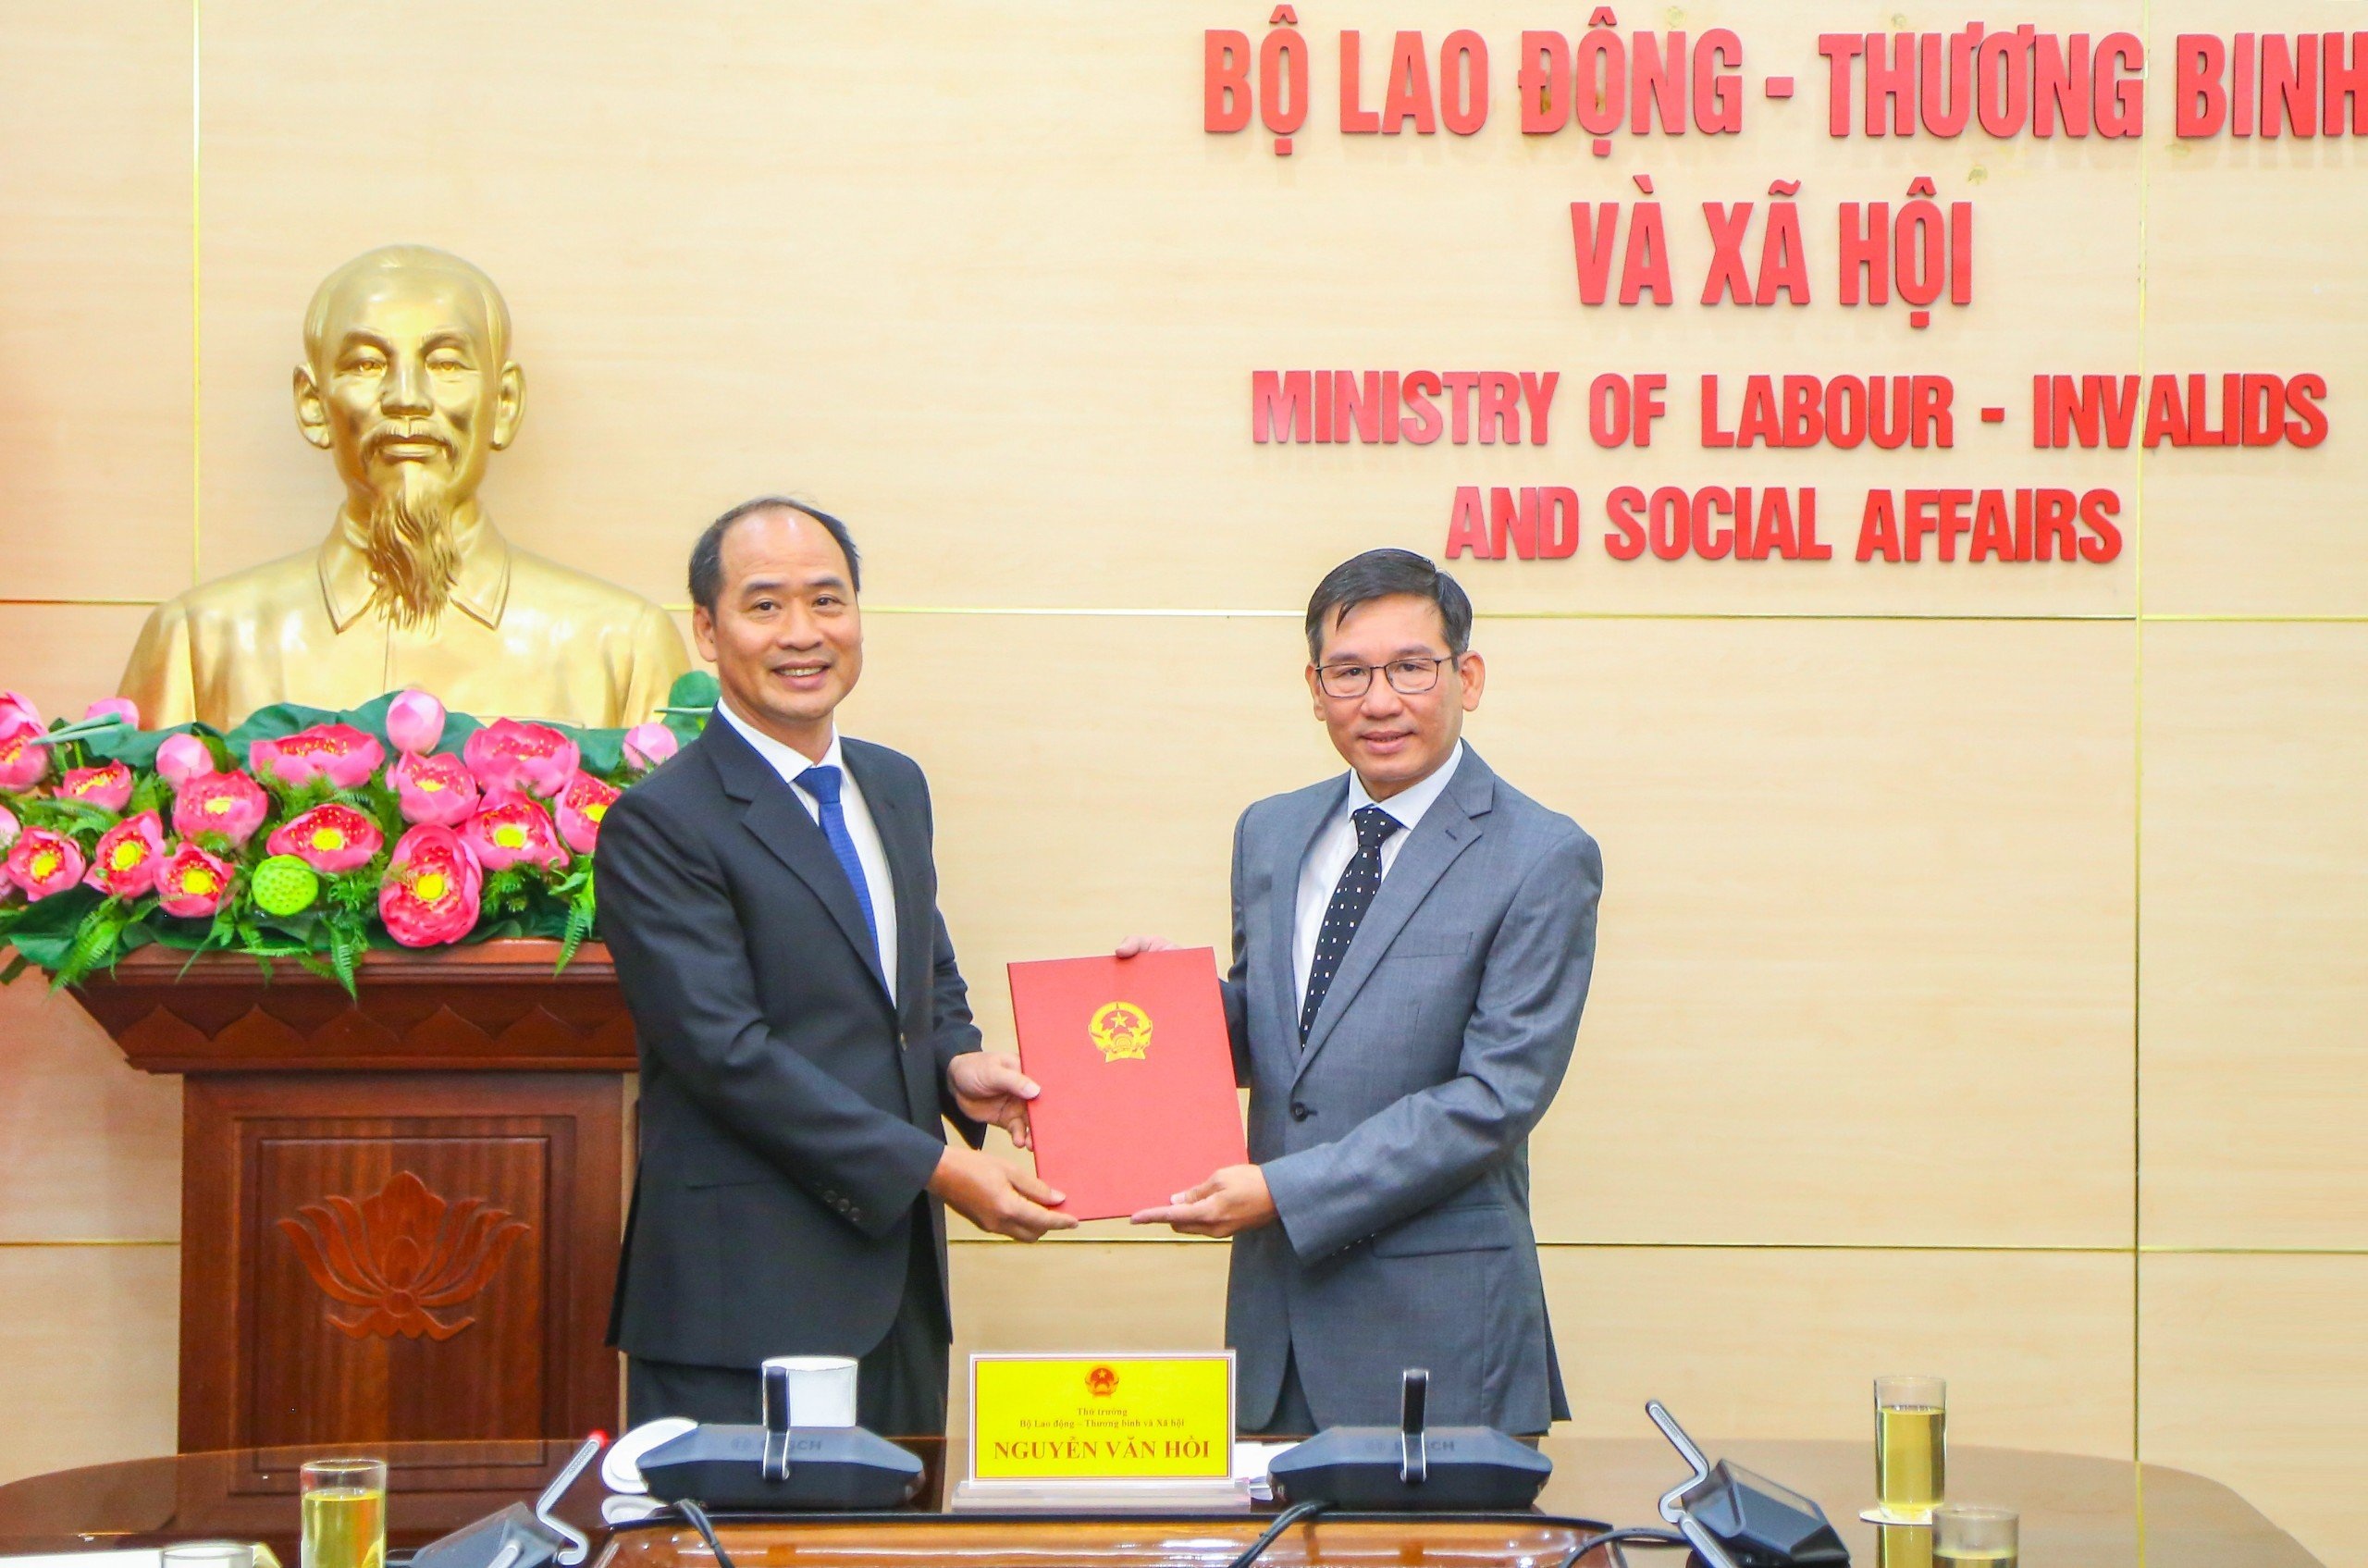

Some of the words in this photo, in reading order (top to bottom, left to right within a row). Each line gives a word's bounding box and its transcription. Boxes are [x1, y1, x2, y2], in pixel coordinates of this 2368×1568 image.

[1204, 4, 1308, 155] BỘ
[1340, 29, 1489, 136] LAO
[1518, 6, 1744, 156] ĐỘNG
[1766, 77, 1794, 99] -
[1819, 21, 2144, 139] THƯƠNG
[2177, 31, 2368, 139] BINH
[1571, 174, 1673, 306] VÀ
[1700, 179, 1810, 306] XÃ
[1839, 176, 1972, 328] HỘI
[1252, 370, 1560, 446] MINISTRY
[1589, 373, 1667, 448] OF
[1700, 374, 1955, 450] LABOUR
[1981, 407, 2005, 423] -
[2033, 373, 2329, 449] INVALIDS
[1445, 486, 1580, 561] AND
[1604, 486, 1832, 562] SOCIAL
[1855, 488, 2123, 563] AFFAIRS
[1034, 1418, 1051, 1428] Lao
[1104, 1435, 1156, 1459] VĂN
